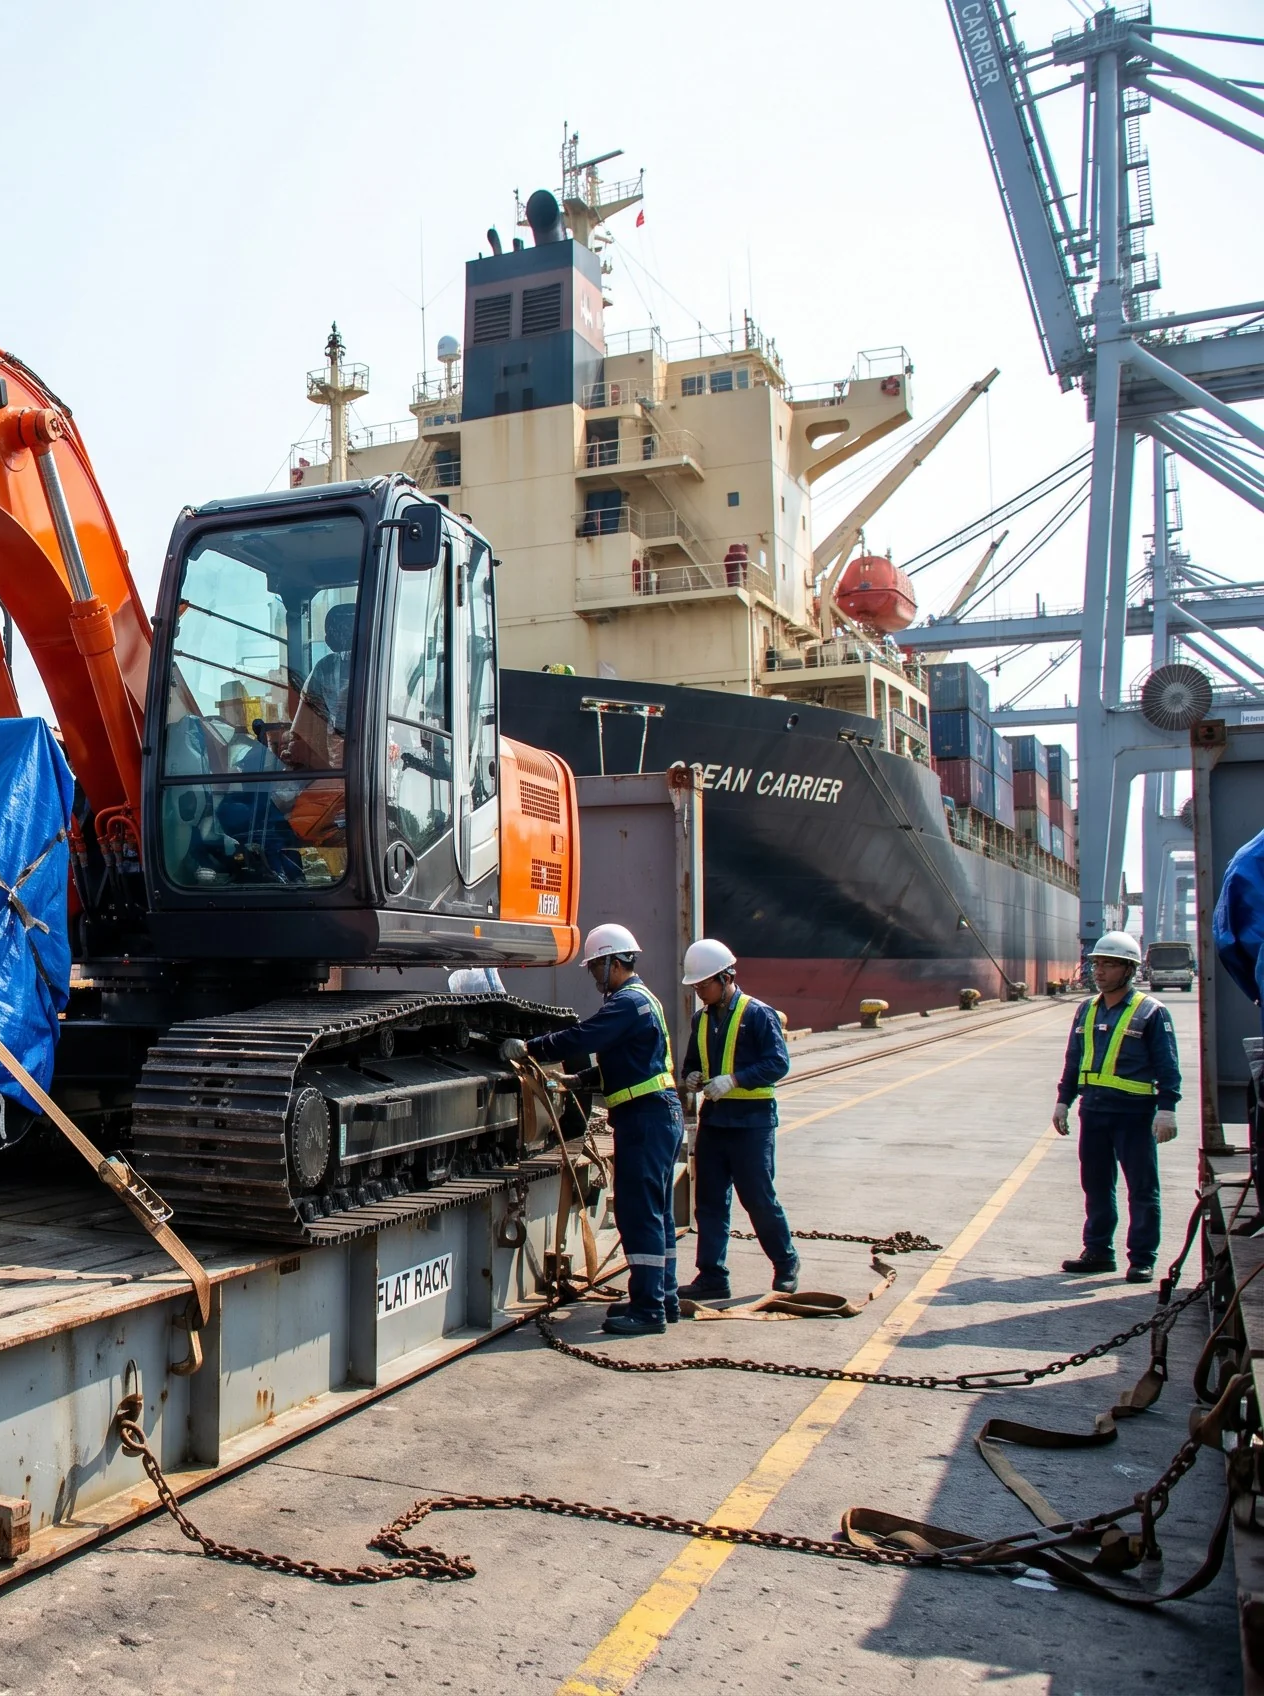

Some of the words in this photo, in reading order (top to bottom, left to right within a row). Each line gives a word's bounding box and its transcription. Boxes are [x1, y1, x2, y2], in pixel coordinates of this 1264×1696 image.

[961, 3, 1000, 88] CARRIER
[756, 771, 843, 803] CARRIER
[377, 1272, 410, 1315] FLAT
[414, 1257, 449, 1300] RACK
